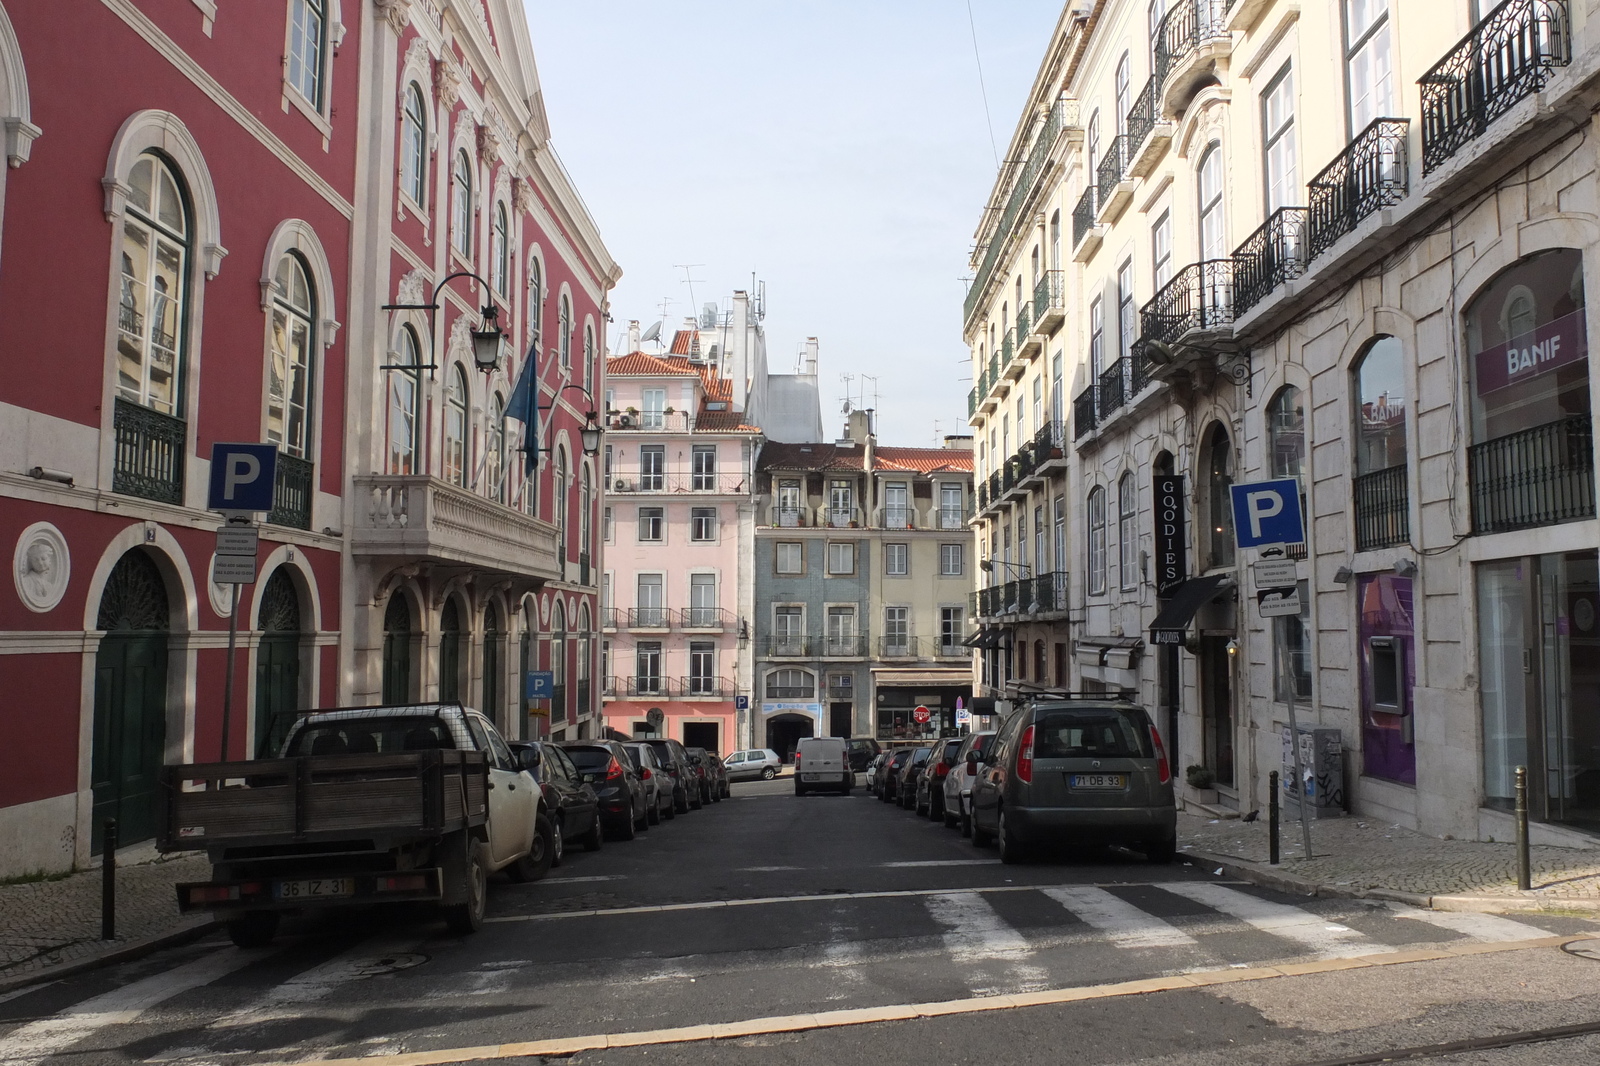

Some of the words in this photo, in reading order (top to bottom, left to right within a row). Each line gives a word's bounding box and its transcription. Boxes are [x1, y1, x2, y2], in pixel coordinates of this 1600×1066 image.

[1507, 335, 1560, 375] BANIF
[224, 453, 260, 500] P
[1162, 481, 1176, 579] GOODIES
[1246, 490, 1283, 538] P
[535, 679, 544, 690] P
[737, 696, 746, 708] P
